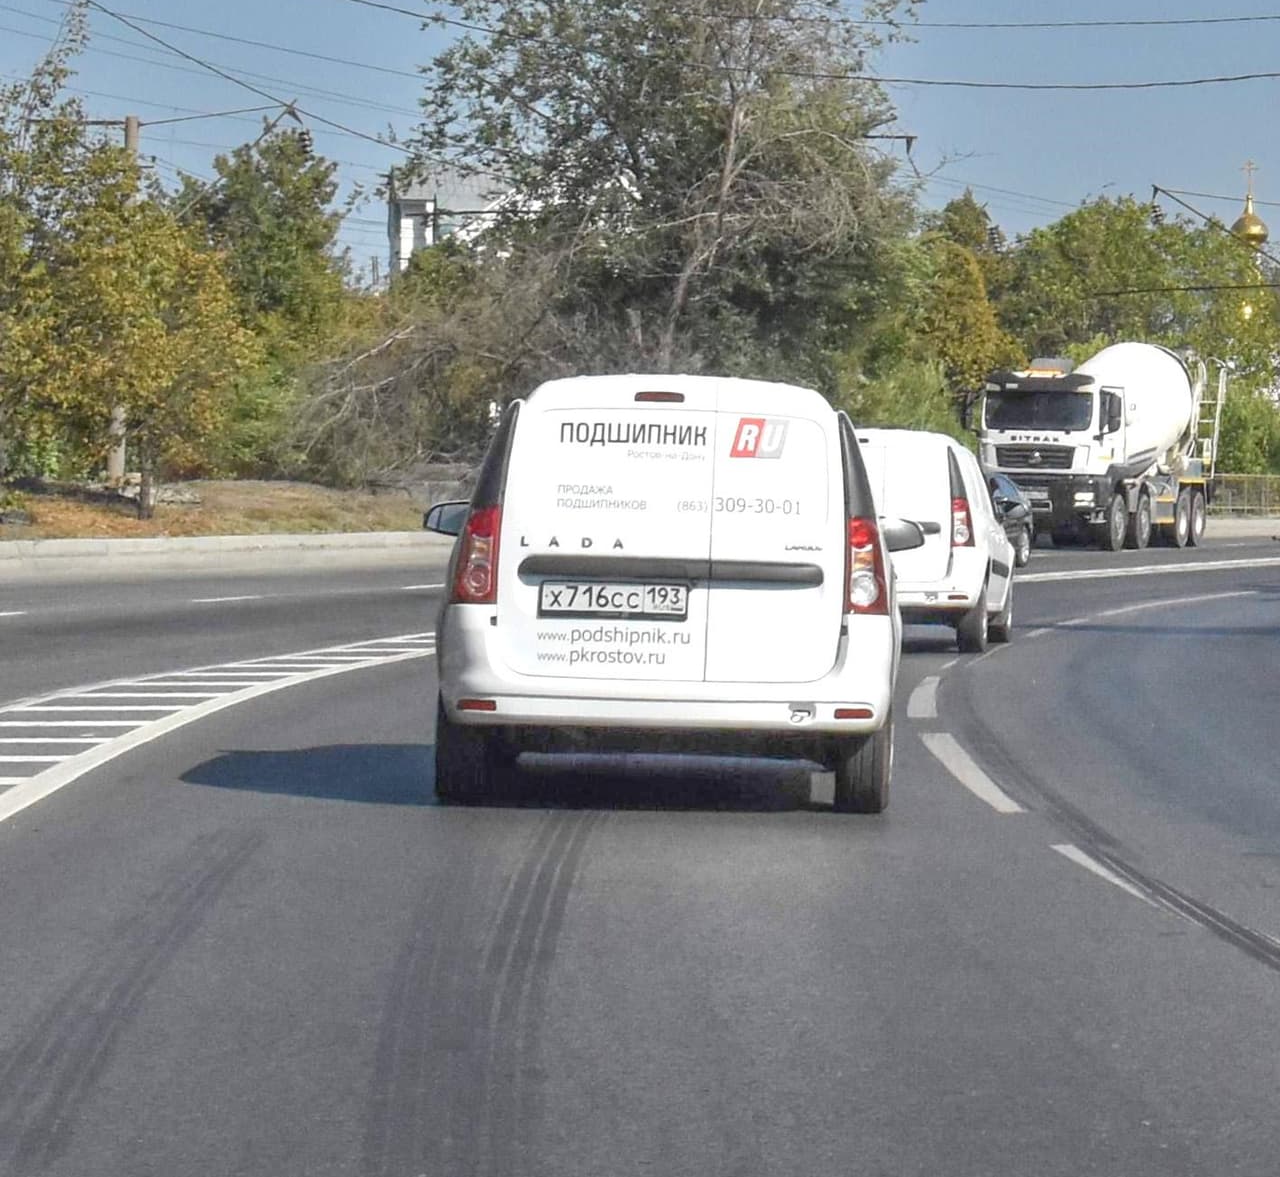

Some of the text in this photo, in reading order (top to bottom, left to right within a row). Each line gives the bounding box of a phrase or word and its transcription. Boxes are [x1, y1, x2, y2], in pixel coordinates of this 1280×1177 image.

[560, 422, 787, 455] ПОДШИПНИК RU
[557, 484, 614, 496] ПРОДАЖА
[556, 498, 647, 511] ПОДШИПНИКОВ
[676, 497, 801, 516] (863) 309-30-01
[520, 535, 624, 550] LADA
[647, 586, 681, 605] 193
[536, 627, 691, 647] www.podshipnik.ru
[536, 647, 666, 666] www.pkrostov.ru
